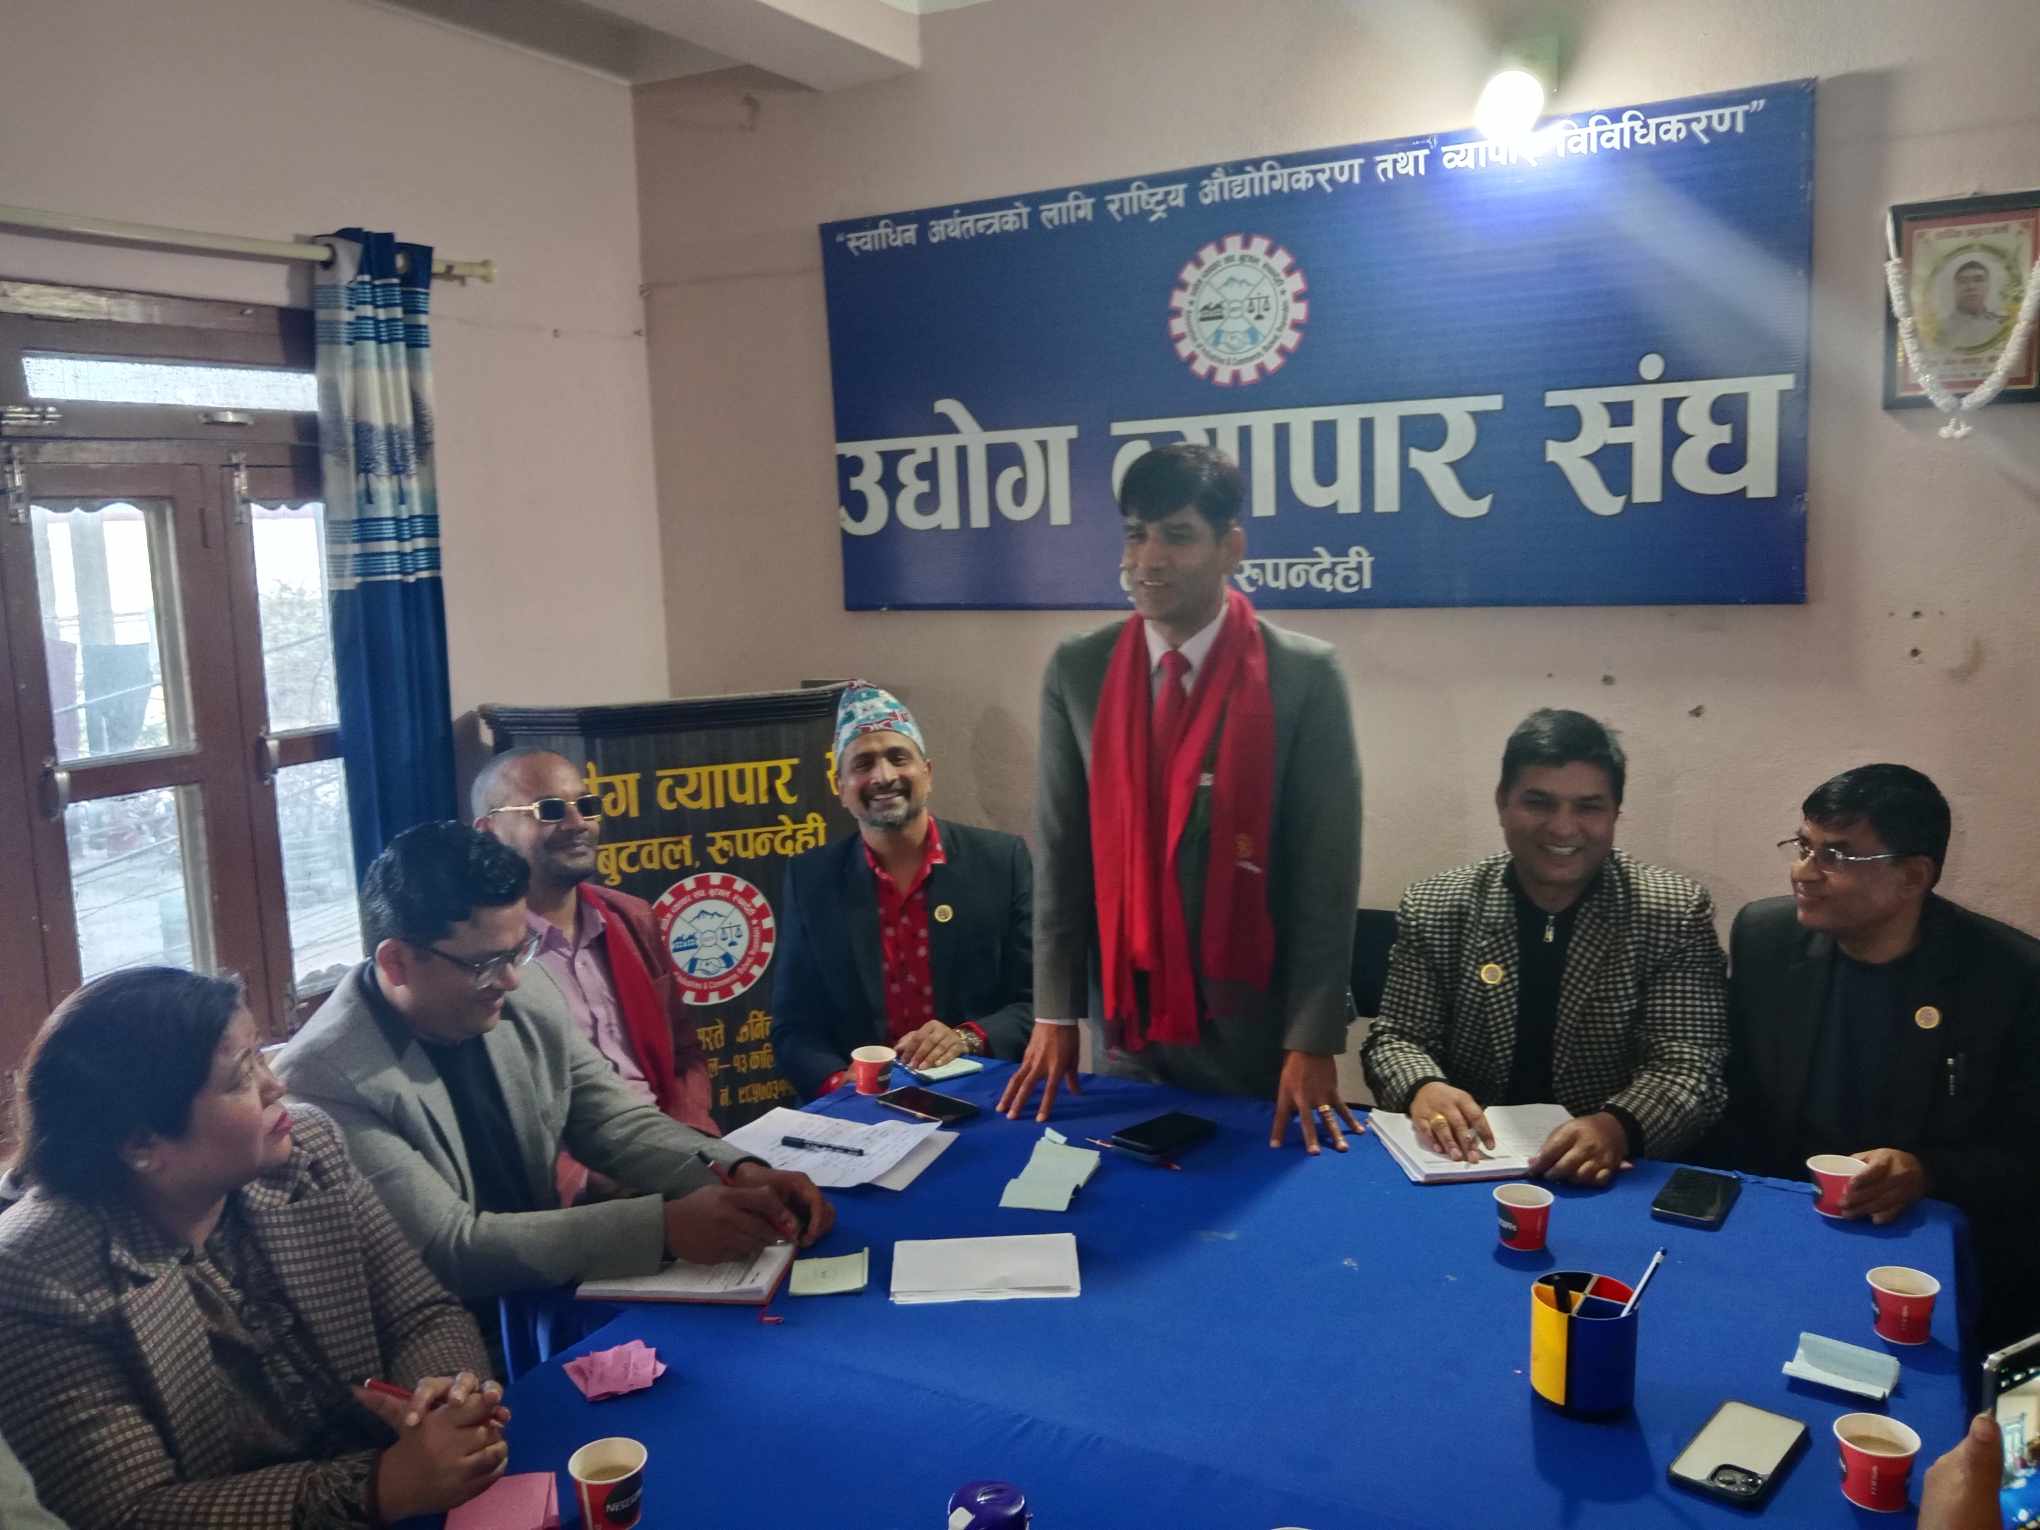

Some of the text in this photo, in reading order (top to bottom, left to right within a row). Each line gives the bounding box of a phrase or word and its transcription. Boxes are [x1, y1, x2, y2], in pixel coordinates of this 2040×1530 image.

[1039, 191, 1096, 229] लागि
[1104, 181, 1189, 222] राष्ट्रिय
[1373, 148, 1430, 181] तथा
[836, 398, 1079, 536] उद्योग
[1544, 353, 1796, 516] संघ
[656, 758, 799, 811] व्यापार
